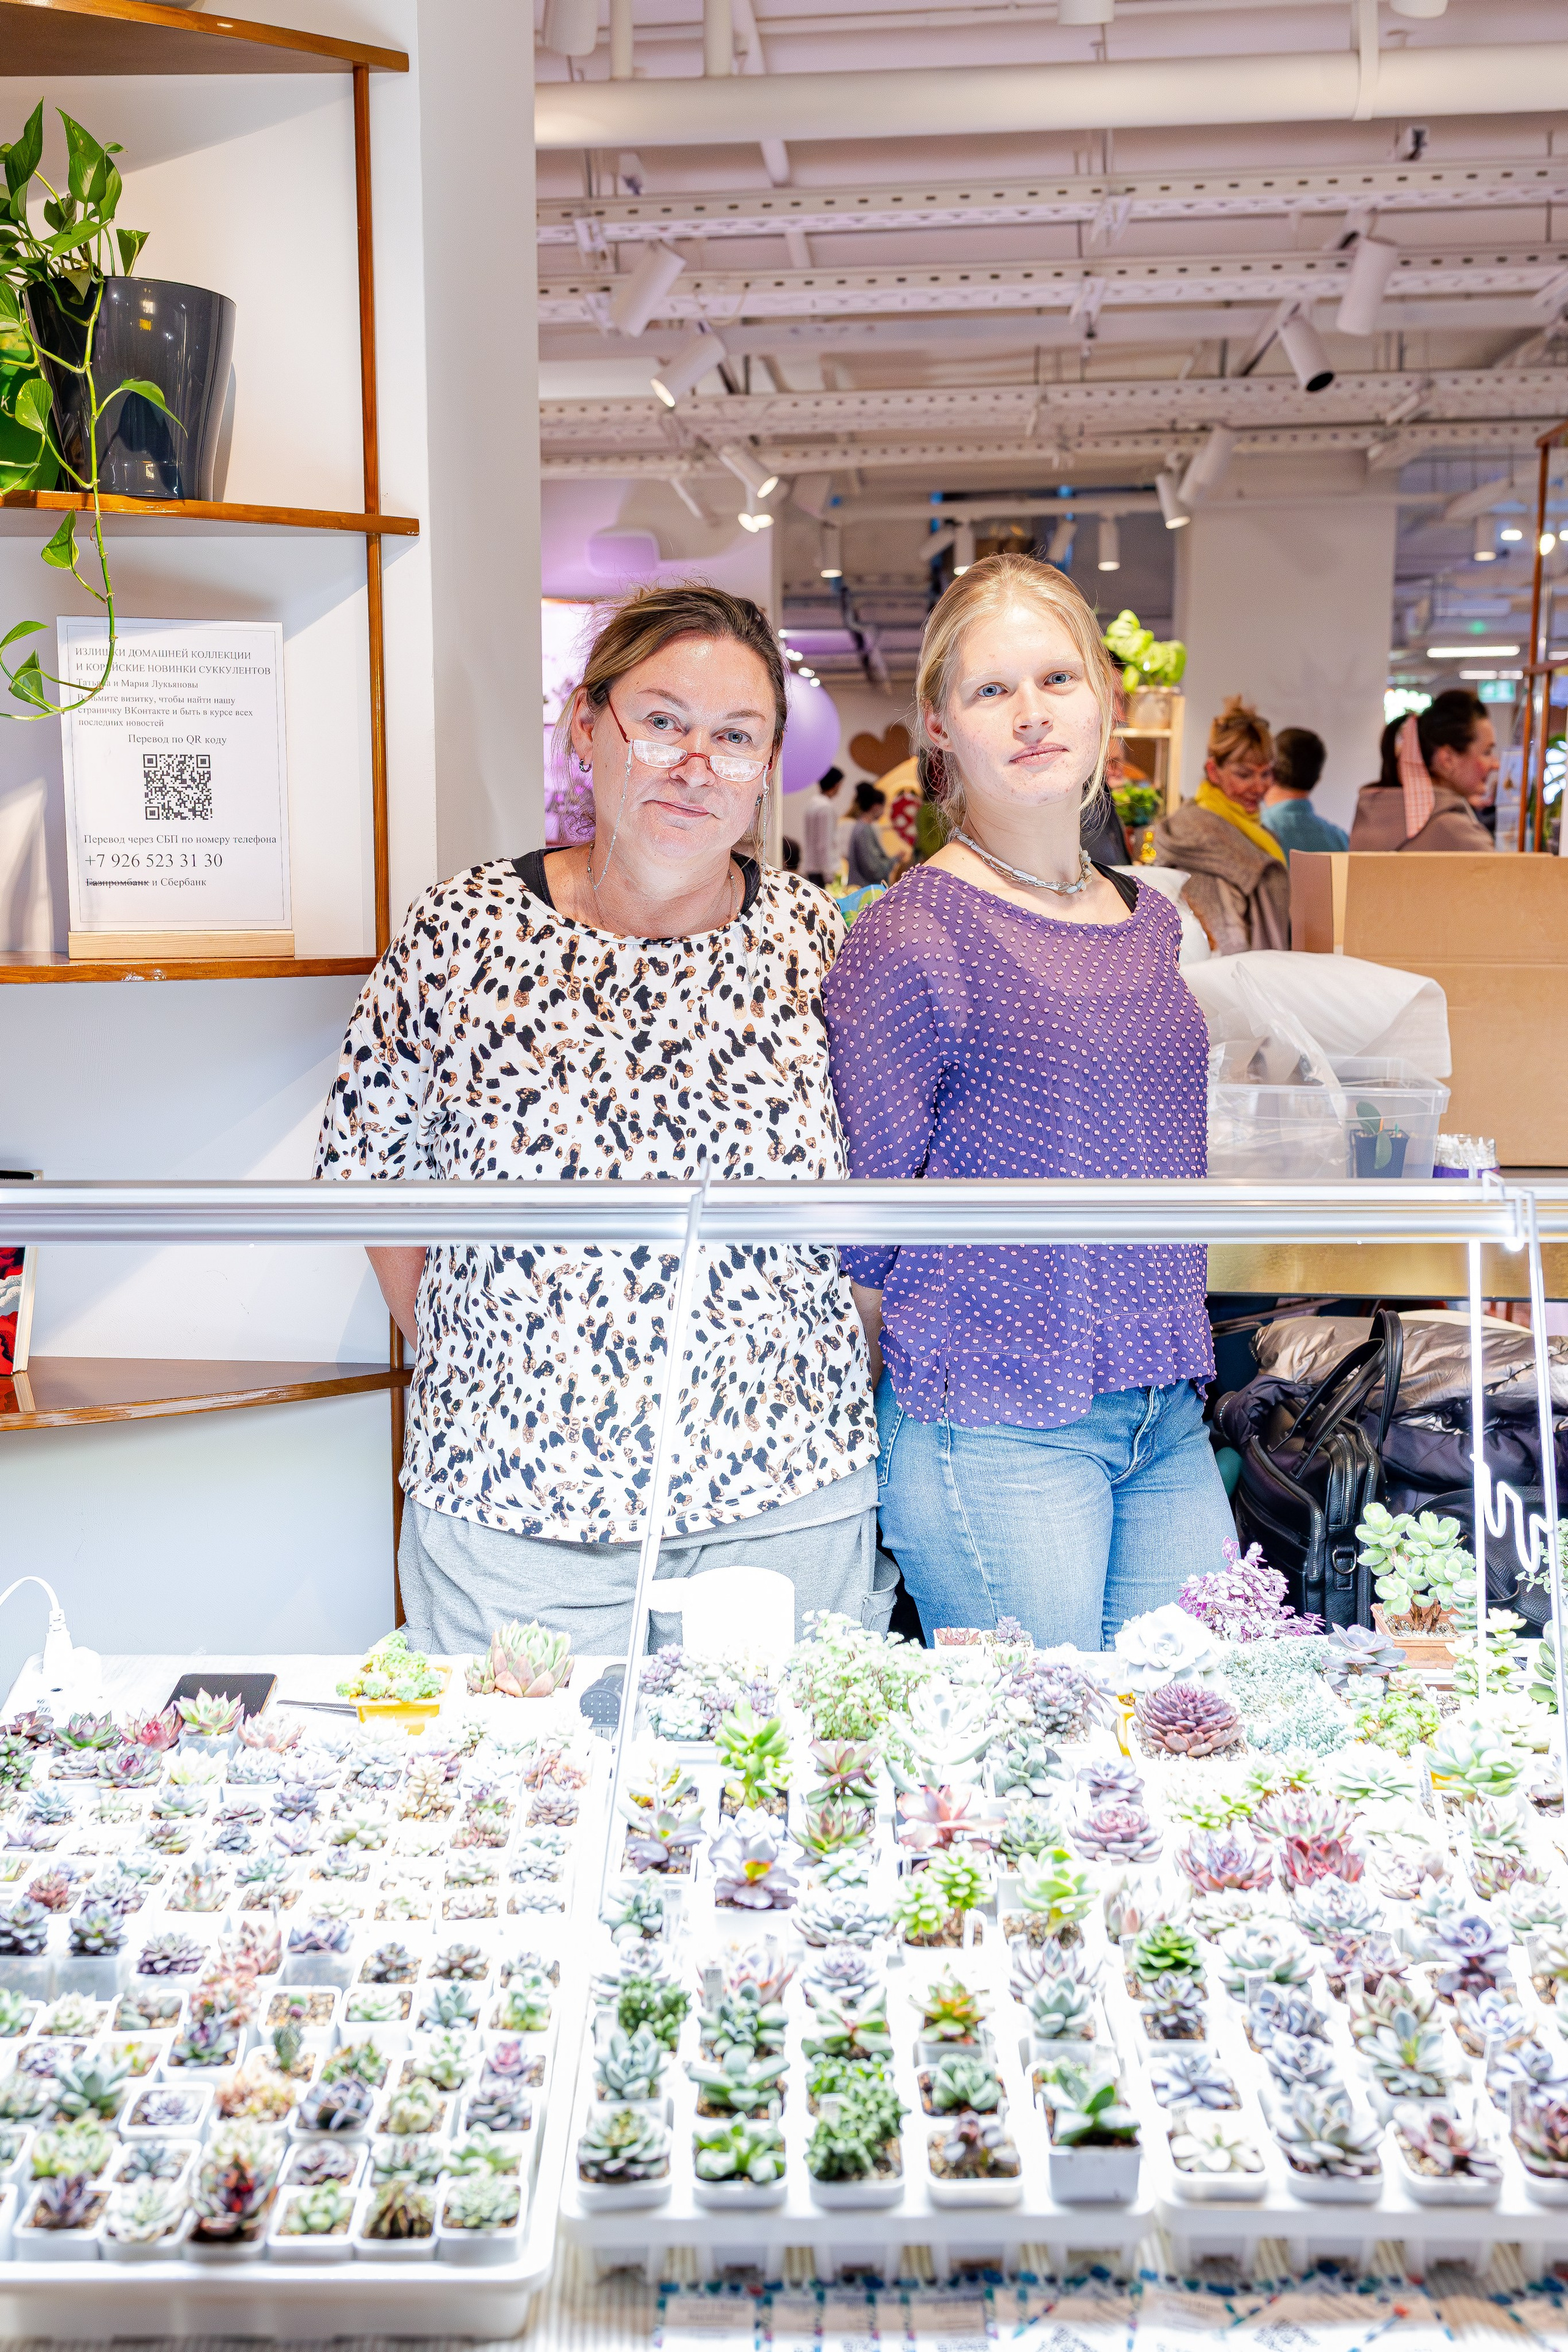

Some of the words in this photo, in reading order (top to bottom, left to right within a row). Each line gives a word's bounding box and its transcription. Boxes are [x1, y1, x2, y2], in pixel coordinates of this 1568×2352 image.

[129, 647, 188, 658] ДОМАШНЕЙ
[191, 650, 251, 660] КОЛЛЕКЦИИ
[86, 663, 145, 672] КОРЙСКИЕ
[199, 665, 271, 675] СУККУЛЕНТОВ
[121, 680, 149, 689] Мария
[152, 680, 198, 689] Лукьяновы
[78, 707, 122, 716] страничку
[125, 707, 170, 715] ВКонтакте
[180, 707, 200, 715] быть
[126, 718, 164, 727] новостей
[129, 734, 168, 745] Перевод
[186, 734, 202, 745] QR
[205, 737, 227, 745] коду
[84, 834, 125, 845] Перевод
[128, 836, 154, 845] через
[157, 834, 178, 844] СБП
[196, 836, 230, 845] номеру
[233, 835, 276, 845] телефона
[85, 854, 105, 868] +7
[111, 854, 140, 868] 926
[146, 854, 173, 868] 523
[180, 854, 197, 868] 31
[205, 854, 222, 868] 30
[160, 878, 206, 888] Сбербанк
